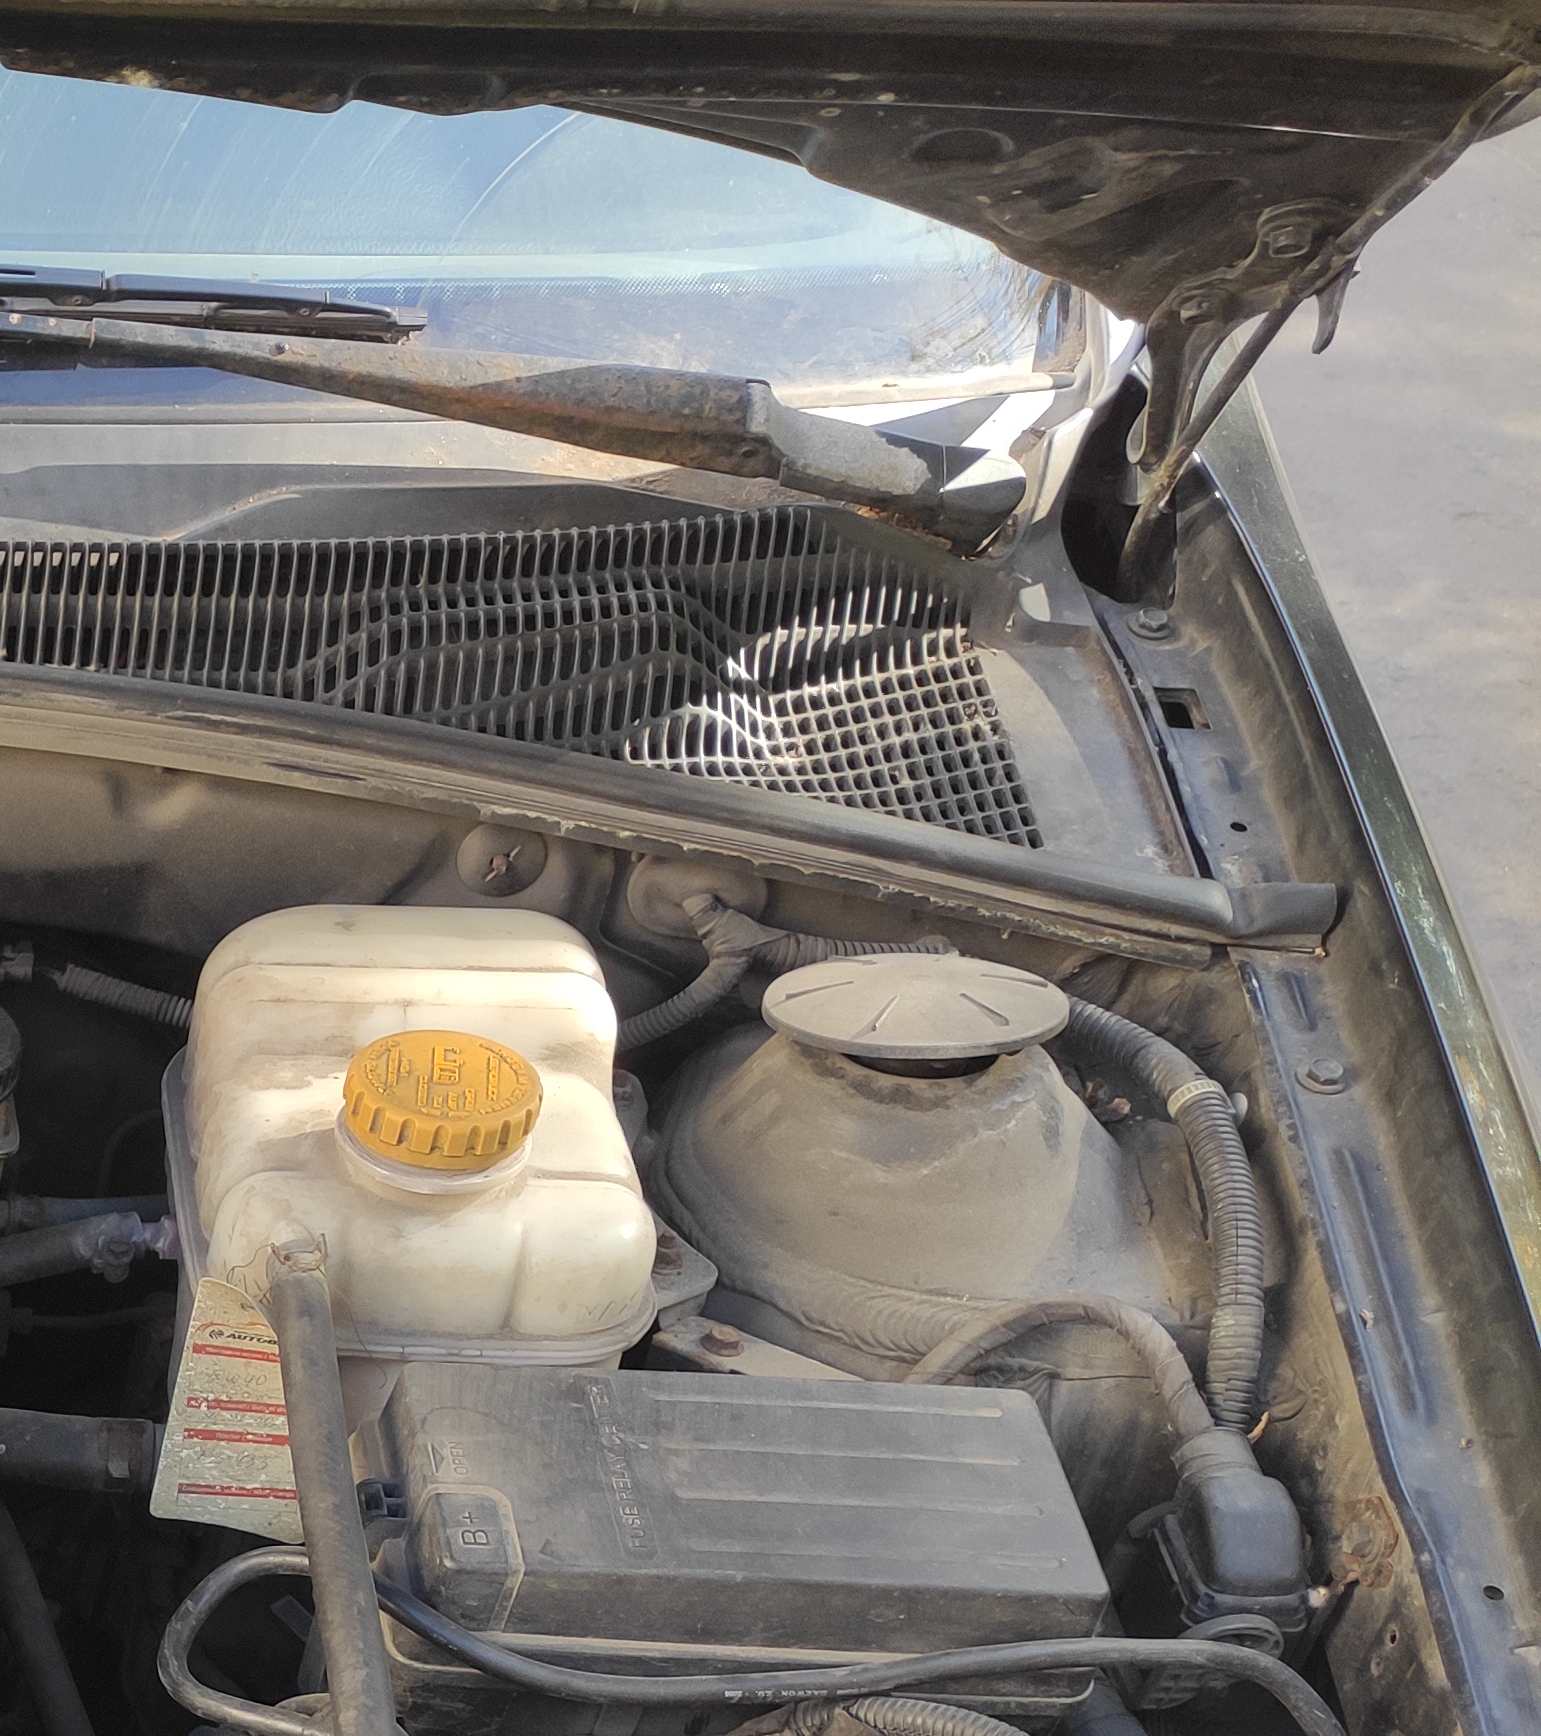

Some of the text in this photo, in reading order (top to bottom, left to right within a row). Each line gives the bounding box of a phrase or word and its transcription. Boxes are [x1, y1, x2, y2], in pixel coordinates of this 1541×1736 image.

[448, 1441, 468, 1475] OPEN
[604, 1450, 632, 1501] RELAY
[461, 1510, 490, 1546] B+
[619, 1505, 647, 1549] FUSE
